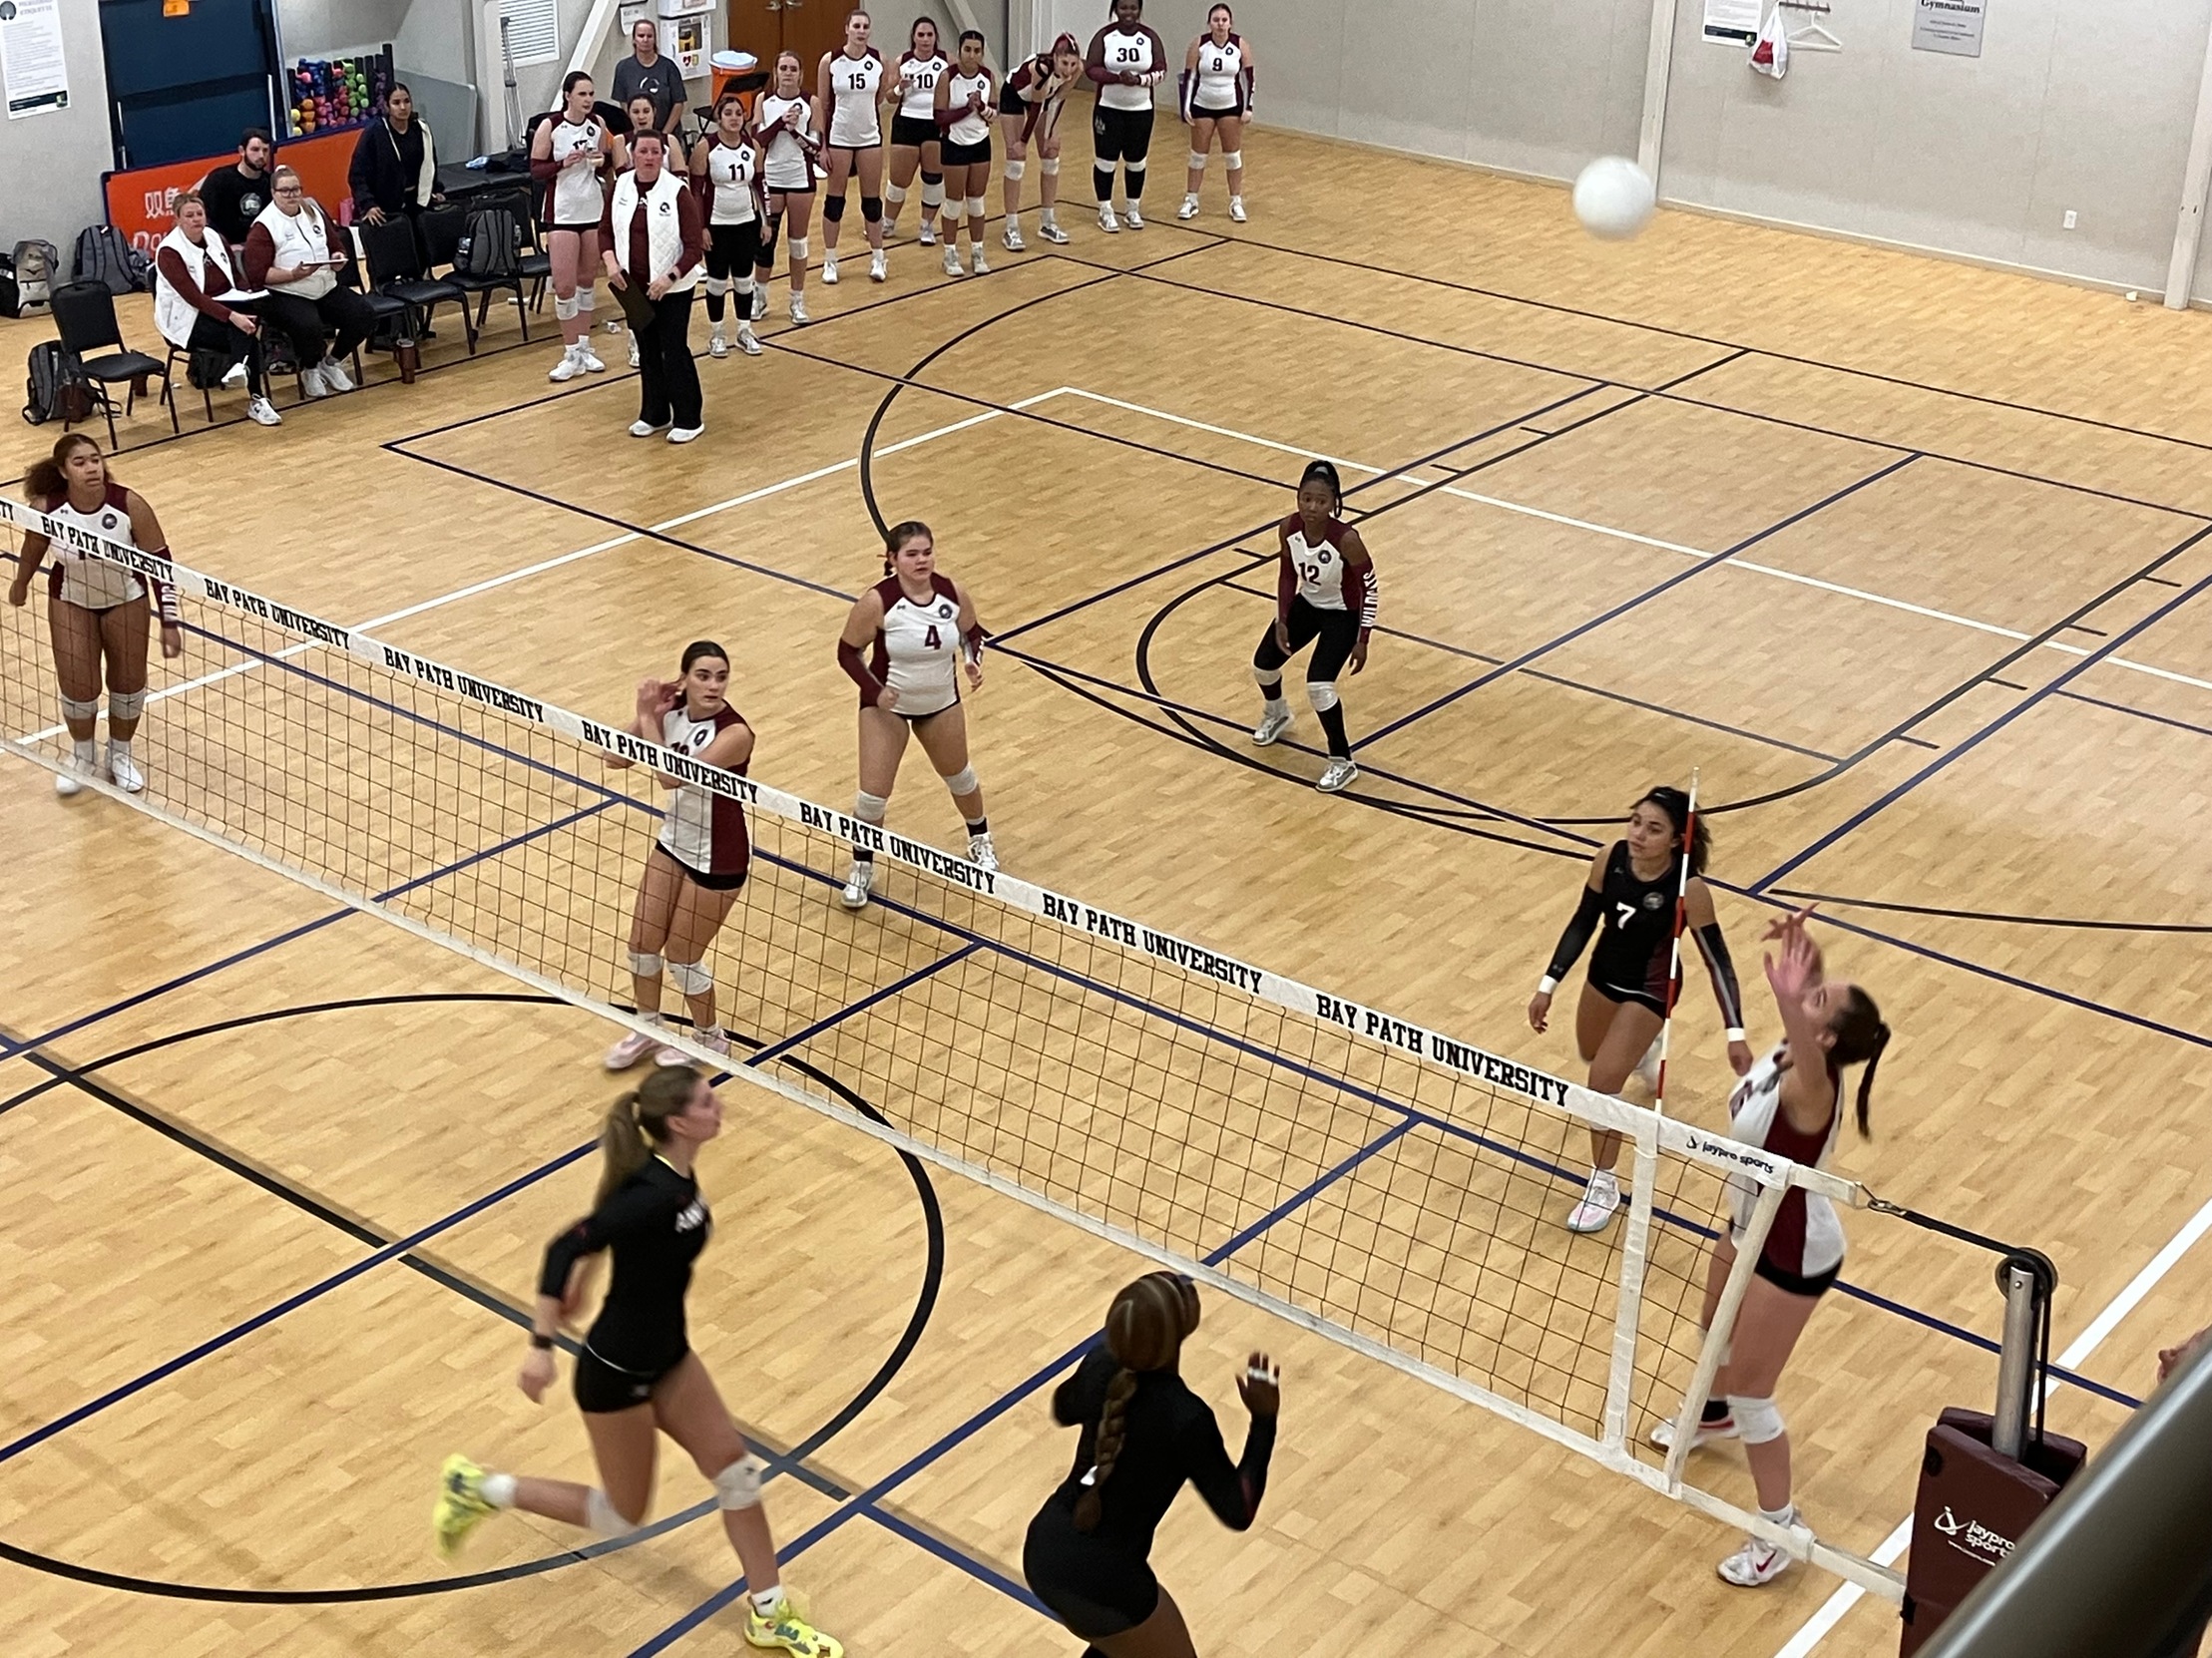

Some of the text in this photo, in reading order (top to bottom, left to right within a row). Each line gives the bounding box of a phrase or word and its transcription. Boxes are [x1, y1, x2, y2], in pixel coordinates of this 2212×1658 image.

[1116, 47, 1139, 63] 30
[1212, 57, 1223, 72] 9
[848, 73, 866, 90] 15
[916, 73, 933, 89] 10
[728, 163, 745, 182] 11
[41, 516, 175, 582] BAY PATH UNIVERSITY
[1298, 562, 1321, 586] 12
[205, 578, 229, 605] BAY
[232, 590, 268, 619] PATH
[270, 604, 349, 649] UNIVERSITY
[925, 625, 942, 650] 4
[383, 647, 544, 722] BAY PATH UNIVERSITY
[582, 720, 758, 804] BAY PATH UNIVERSITY
[799, 802, 995, 894] BAY PATH UNIVERSITY
[1616, 901, 1637, 930] 7
[1043, 893, 1262, 995] BAY PATH UNIVERSITY
[1316, 994, 1569, 1106] BAY PATH UNIVERSITY
[1702, 1141, 1774, 1174] jaypro sports
[1966, 1519, 2015, 1550] jaypro
